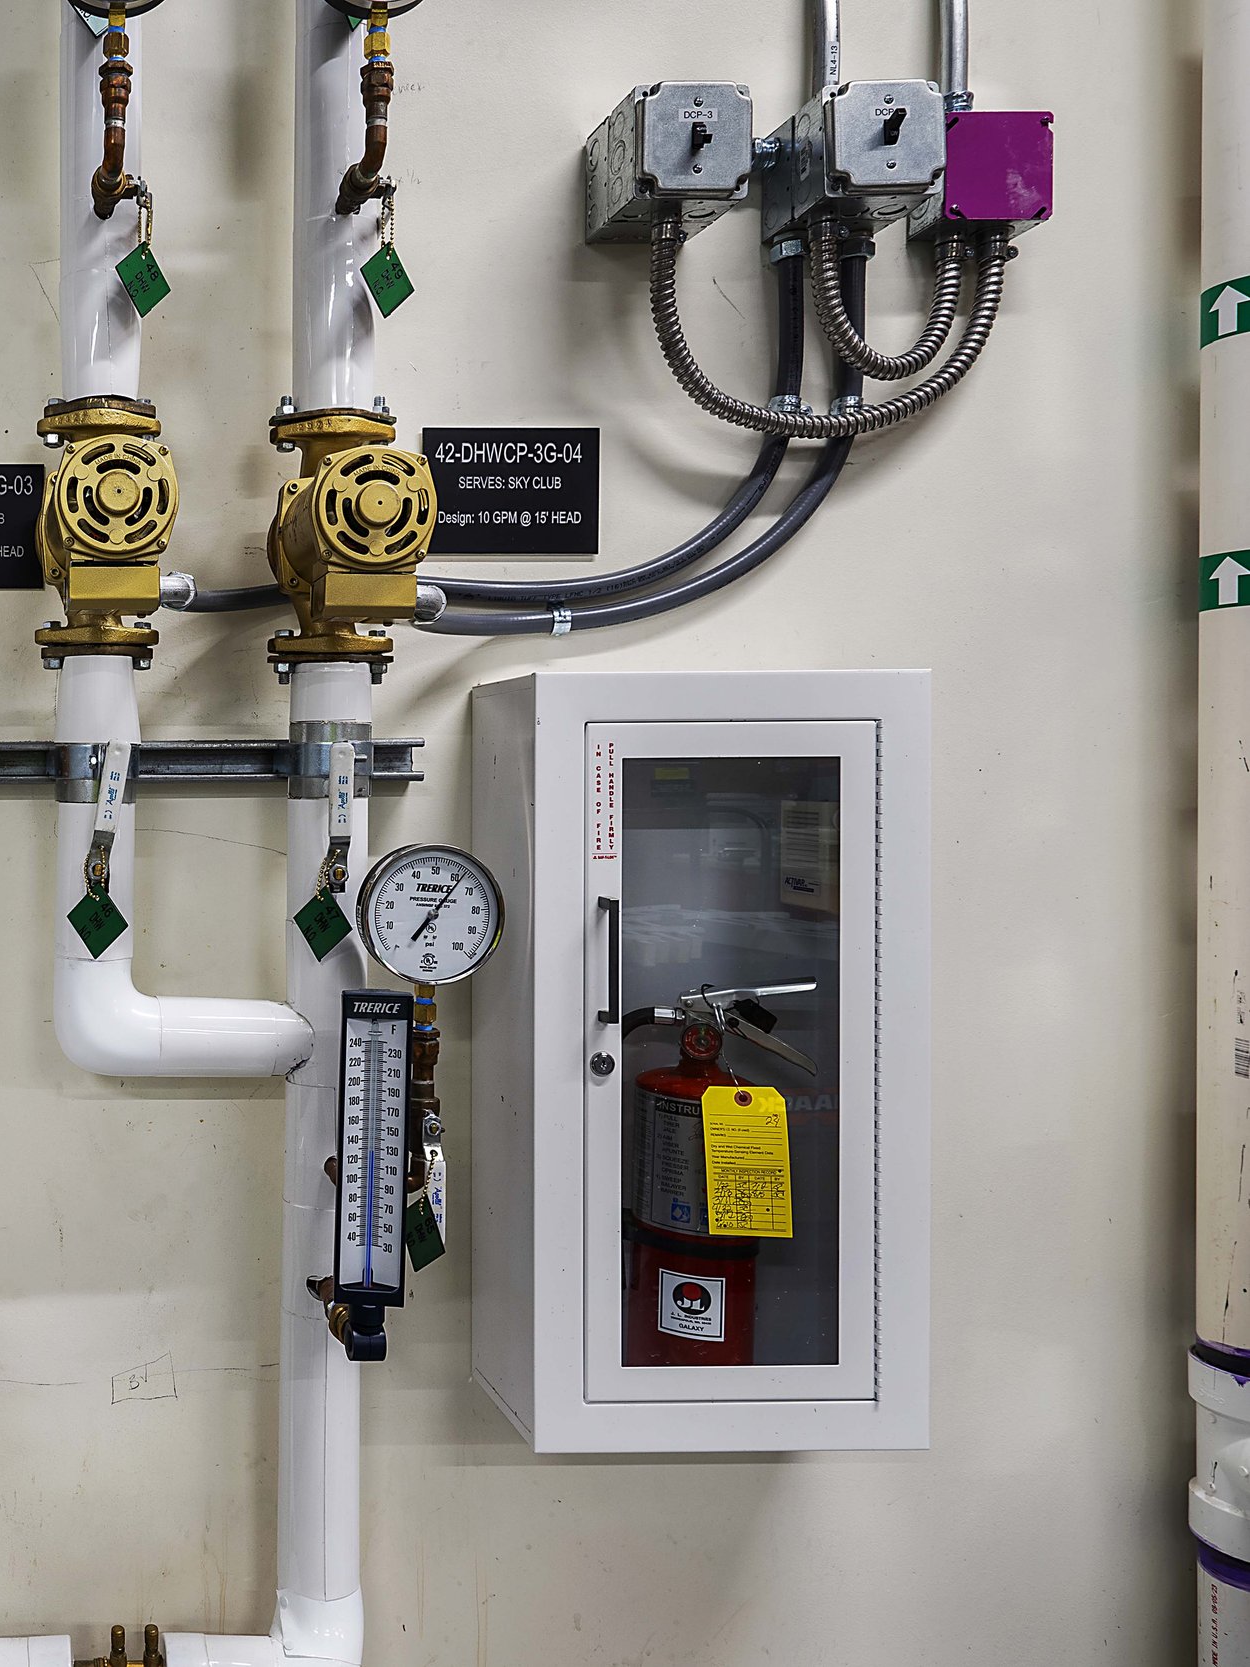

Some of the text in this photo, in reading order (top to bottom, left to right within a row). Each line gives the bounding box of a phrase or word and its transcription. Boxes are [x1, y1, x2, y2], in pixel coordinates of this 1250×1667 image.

[830, 45, 838, 76] NL4-13
[683, 110, 713, 119] DCP-3
[875, 108, 894, 116] DCP
[146, 263, 159, 282] 48
[391, 262, 404, 280] 49
[135, 271, 150, 293] DHW
[381, 269, 395, 289] DHW
[435, 442, 583, 464] 42-DHWCP-3G-04
[94, 454, 113, 465] MADE
[122, 454, 142, 466] CHINA
[353, 465, 371, 477] MADE
[381, 465, 401, 477] CHINA
[458, 476, 562, 489] SERVES: SKY CLUB
[438, 511, 475, 526] Design:
[478, 511, 490, 524] 10
[492, 511, 518, 524] GPM
[534, 511, 549, 524] 15'
[551, 511, 582, 524] HEAD
[595, 744, 602, 757] IN
[595, 802, 602, 814] OF
[411, 870, 421, 879] 40
[431, 866, 441, 875] 50
[450, 873, 459, 882] 60
[395, 882, 404, 892] 30
[416, 883, 453, 893] TRERICE
[464, 887, 473, 896] 70
[385, 900, 394, 910] 20
[471, 906, 481, 914] 80
[101, 903, 114, 918] 46
[325, 906, 340, 920] 47
[386, 921, 393, 929] 10
[467, 926, 476, 934] 90
[452, 942, 464, 951] 100
[353, 1001, 401, 1014] TRERICE
[391, 1024, 397, 1034] F
[349, 1037, 362, 1047] 240
[387, 1048, 402, 1059] 230
[349, 1057, 361, 1067] 220
[387, 1068, 400, 1078] 210
[348, 1076, 361, 1086] 200
[387, 1088, 400, 1098] 190
[348, 1096, 360, 1105] 180
[386, 1107, 399, 1117] 170
[658, 1100, 700, 1115] INSTRU
[348, 1116, 359, 1125] 160
[386, 1127, 399, 1137] 150
[347, 1135, 359, 1144] 140
[385, 1146, 399, 1156] 130
[347, 1154, 358, 1164] 120
[385, 1165, 397, 1176] 110
[346, 1174, 357, 1183] 100
[384, 1185, 394, 1195] 90
[348, 1193, 357, 1202] 80
[384, 1204, 393, 1214] 70
[348, 1212, 357, 1222] 60
[383, 1224, 393, 1233] 50
[347, 1232, 356, 1241] 40
[382, 1243, 392, 1253] 30
[678, 1323, 704, 1332] GALAXY
